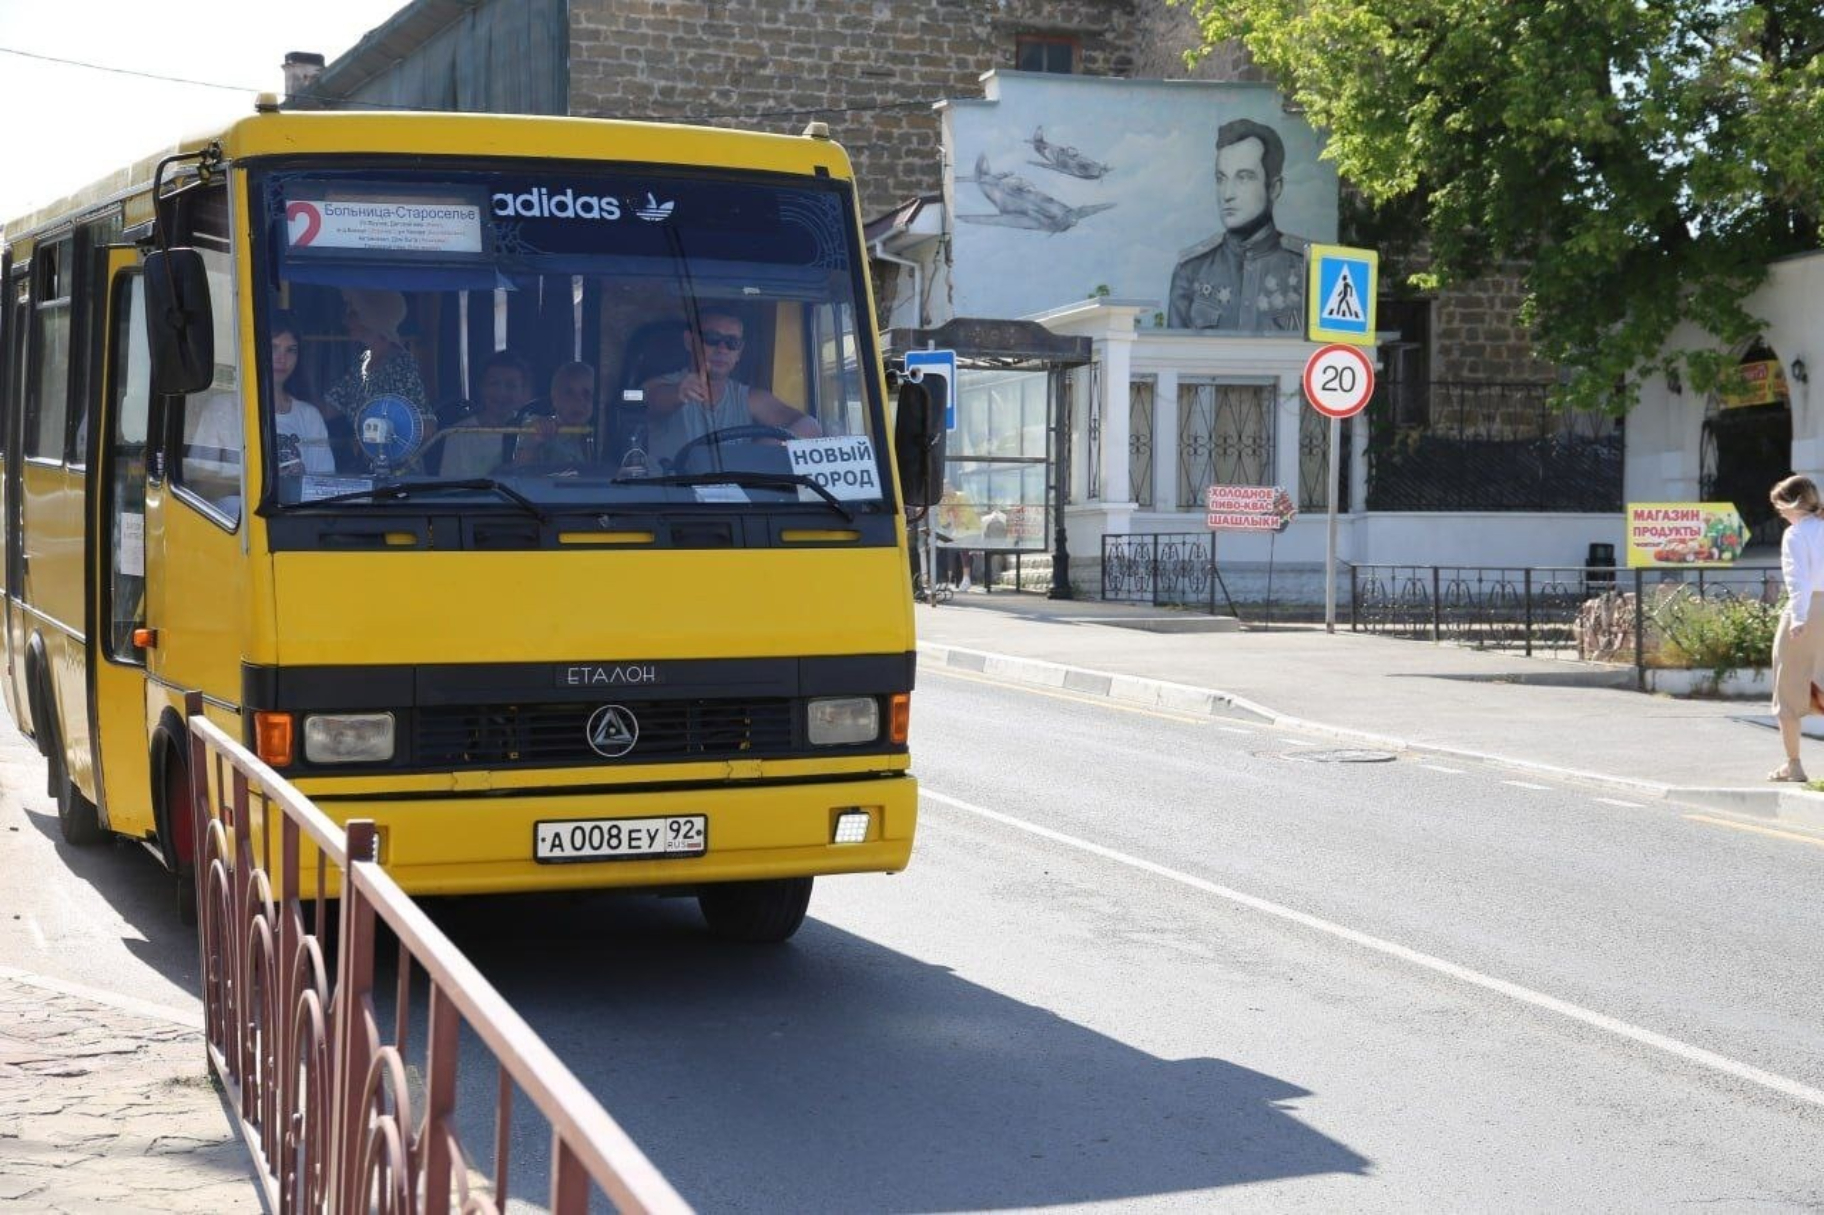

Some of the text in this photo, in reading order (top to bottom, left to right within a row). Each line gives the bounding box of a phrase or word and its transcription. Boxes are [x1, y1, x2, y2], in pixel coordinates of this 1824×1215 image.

[324, 203, 476, 221] Больница-Староселье
[492, 187, 621, 220] adidas
[286, 201, 322, 250] 2
[1321, 365, 1356, 393] 20
[793, 441, 873, 466] НОВЫЙ
[1211, 487, 1274, 500] ХОЛОДНОЕ
[1210, 501, 1273, 512] ПИВО-КВАС
[1632, 509, 1701, 522] МАГАЗИН
[1209, 515, 1280, 527] ШАШЛЫКИ
[1632, 526, 1702, 538] ПРОДУКТЫ
[567, 666, 656, 685] ЕТАЛОН
[668, 819, 695, 840] 92
[667, 840, 687, 850] RUS
